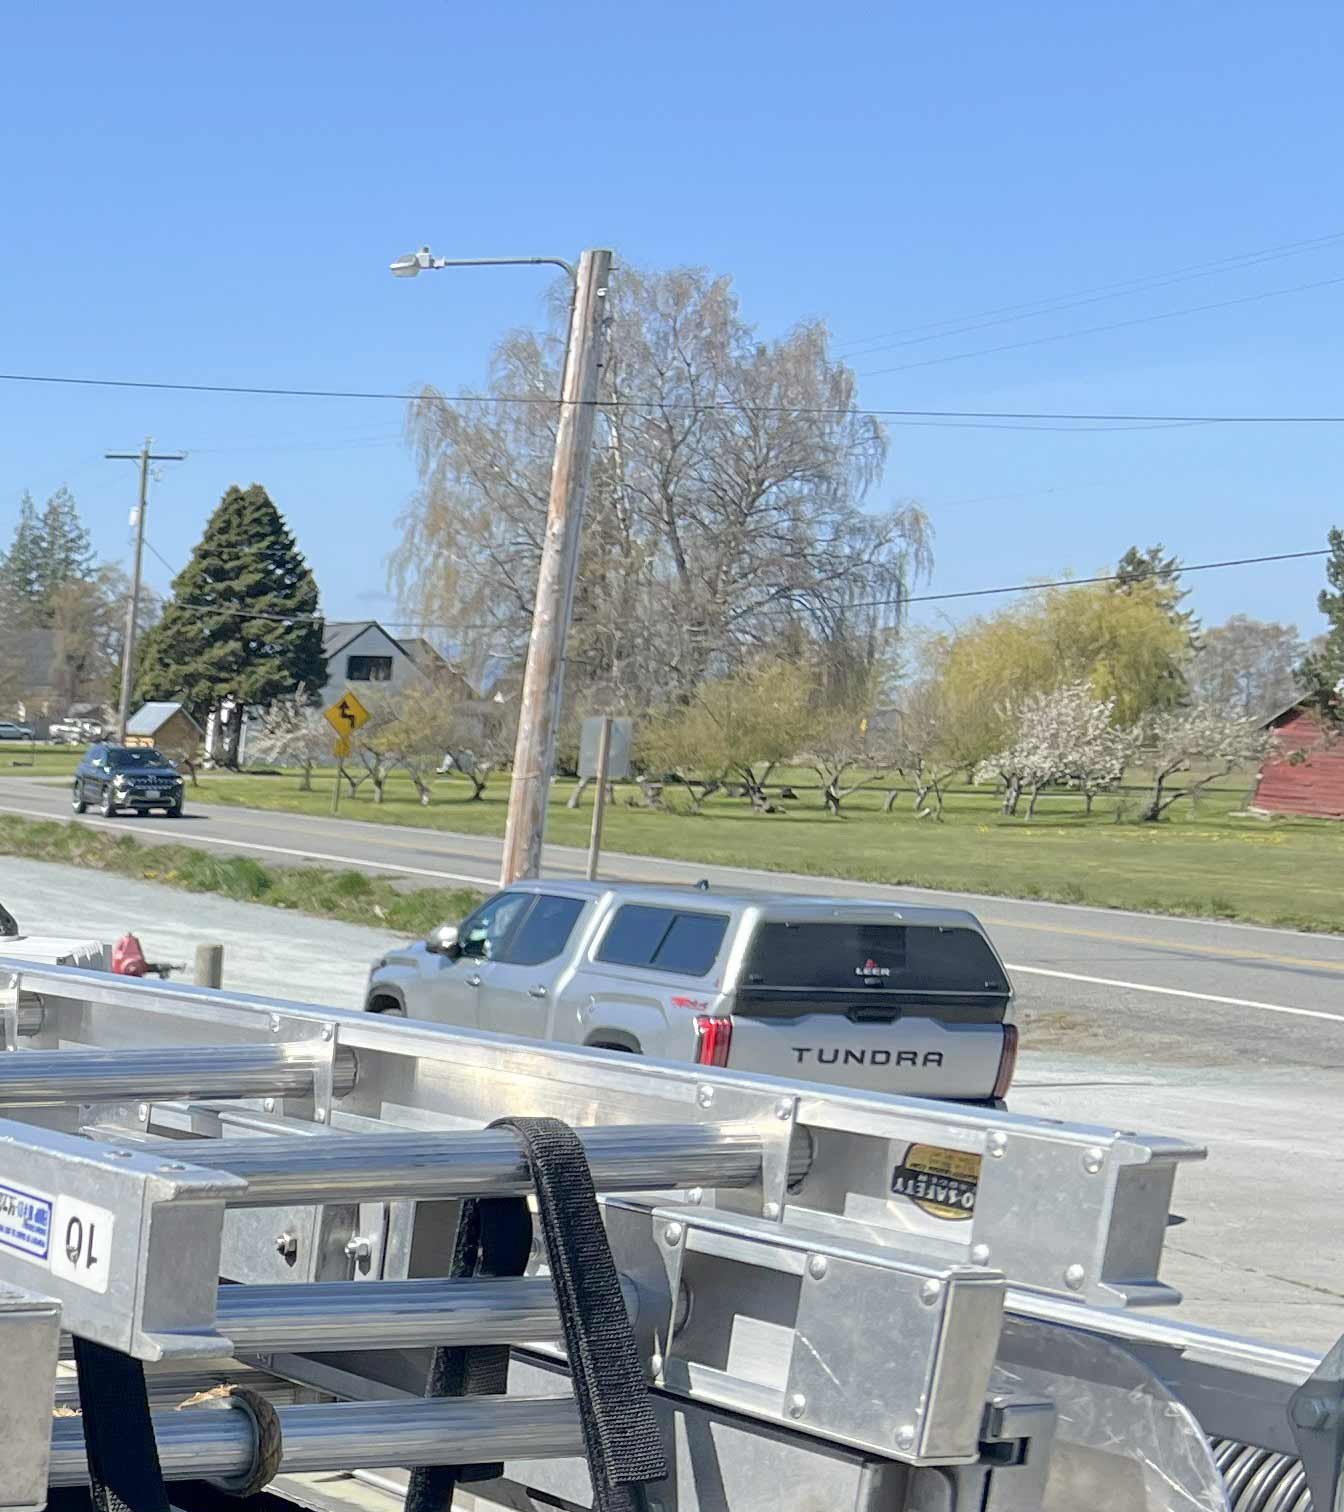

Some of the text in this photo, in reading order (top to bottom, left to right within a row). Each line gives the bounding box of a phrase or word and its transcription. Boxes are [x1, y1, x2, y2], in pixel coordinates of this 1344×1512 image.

[791, 1047, 945, 1068] TUNDRA
[893, 1177, 974, 1209] O-SAFETY
[66, 1215, 98, 1270] 10
